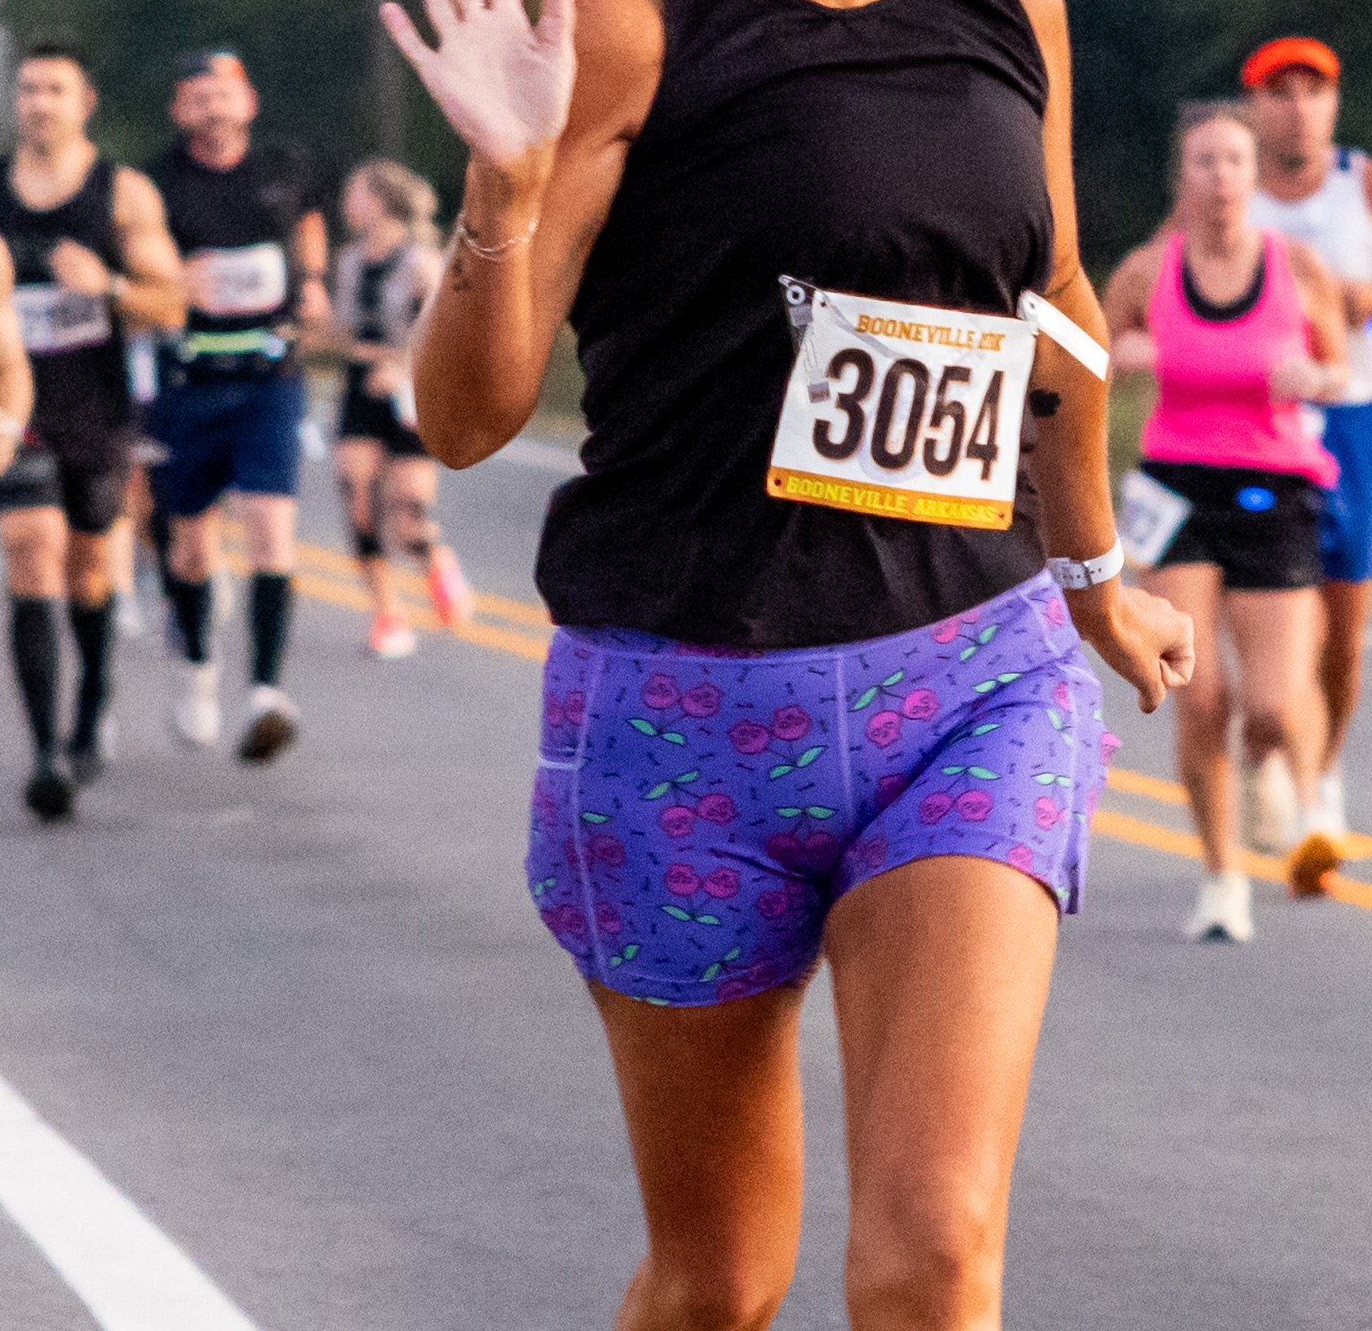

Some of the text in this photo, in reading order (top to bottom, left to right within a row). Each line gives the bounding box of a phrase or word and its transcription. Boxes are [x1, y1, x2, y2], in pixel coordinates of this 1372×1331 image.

[855, 313, 976, 349] BOONEVILLE
[812, 347, 1005, 481] 3054
[785, 476, 909, 513] BOONEVILLE
